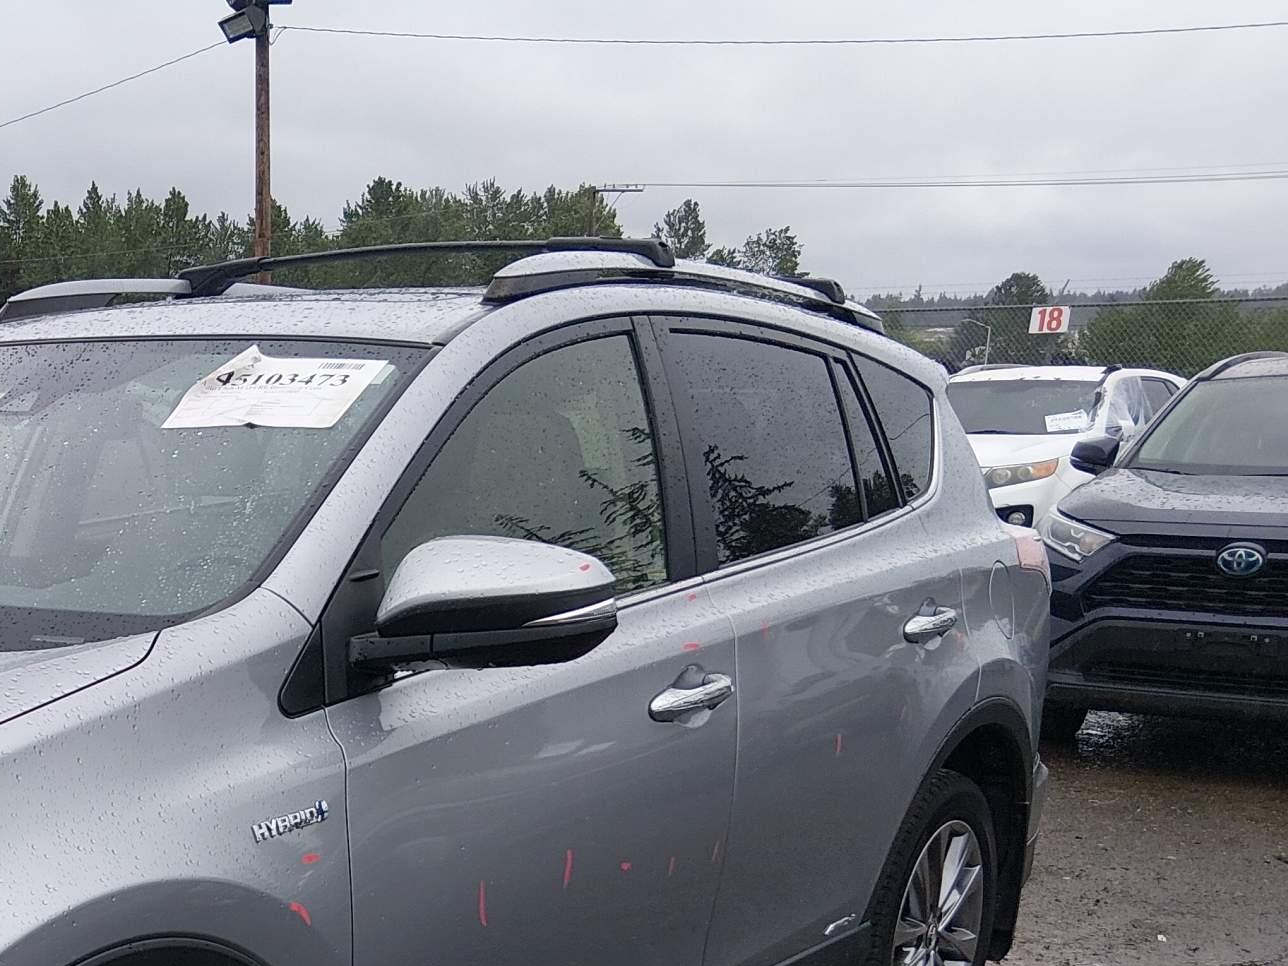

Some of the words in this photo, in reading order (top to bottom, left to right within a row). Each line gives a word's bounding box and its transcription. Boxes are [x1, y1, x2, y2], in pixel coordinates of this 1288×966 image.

[1038, 307, 1063, 332] 18
[216, 371, 350, 386] 45103473
[252, 807, 317, 843] HYBRID
